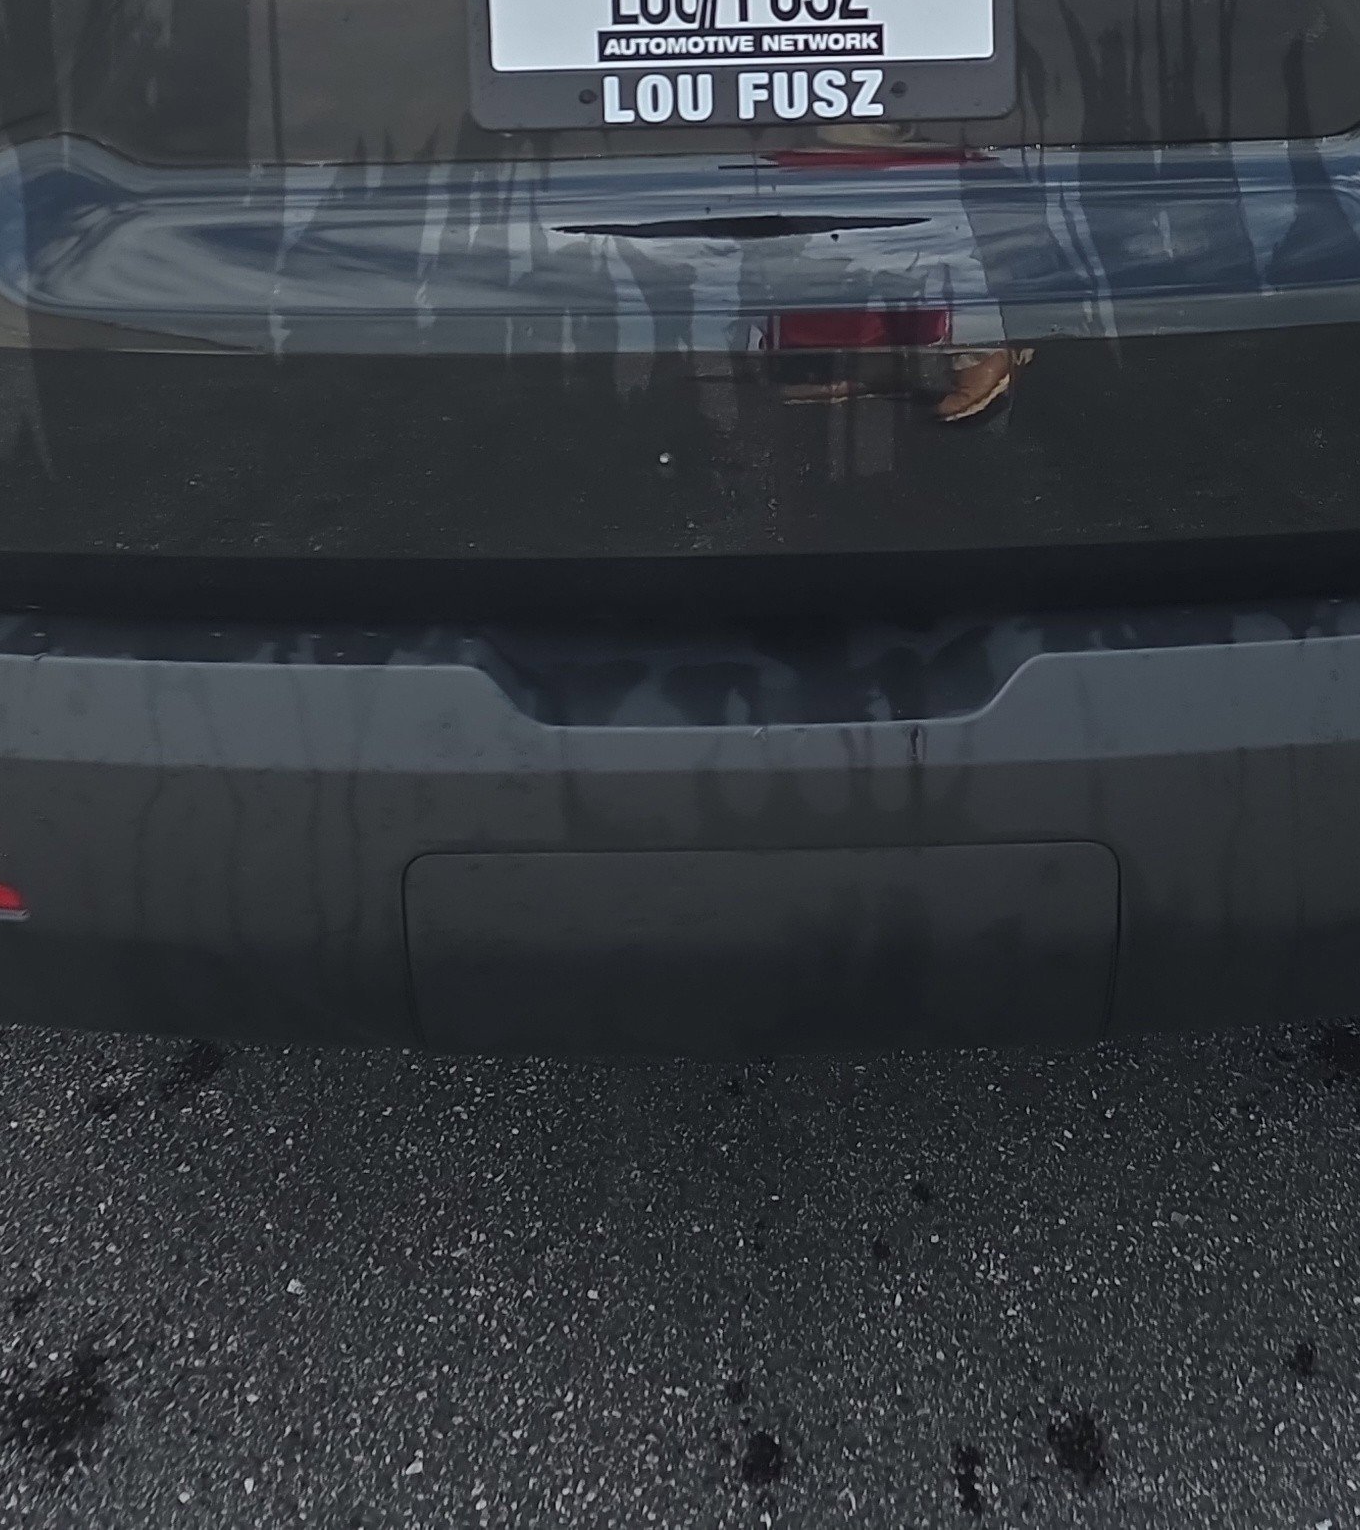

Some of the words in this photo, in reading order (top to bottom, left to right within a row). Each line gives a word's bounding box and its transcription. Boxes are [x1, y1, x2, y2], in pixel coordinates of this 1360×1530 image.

[603, 35, 754, 56] AUTOMOTIVE
[761, 31, 879, 52] NETWORK
[602, 74, 714, 124] LOU
[738, 70, 885, 120] FUSZ
